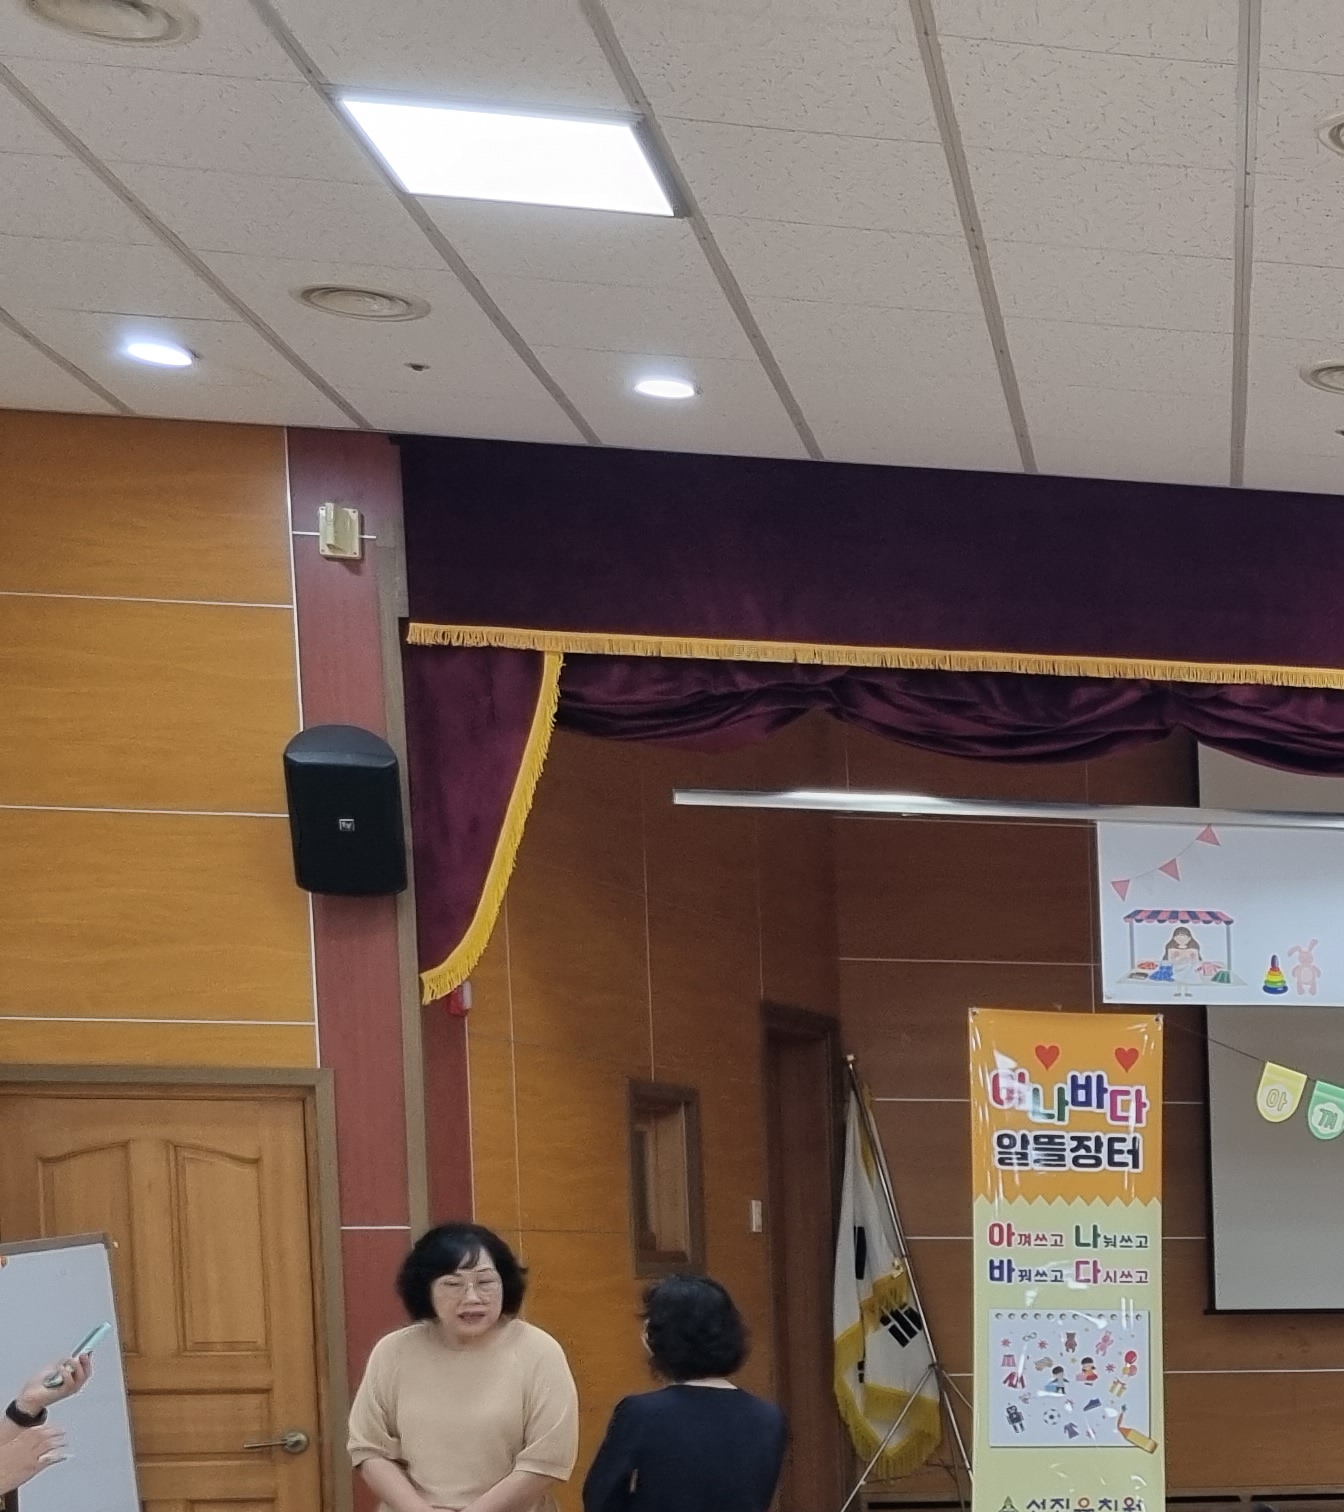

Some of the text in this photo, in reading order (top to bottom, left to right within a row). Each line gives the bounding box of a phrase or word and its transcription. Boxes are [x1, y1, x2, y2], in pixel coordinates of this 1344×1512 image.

[996, 1132, 1140, 1169] 알뜰장터
[988, 1223, 1148, 1249] 아껴쓰고 나눠쓰고
[988, 1258, 1148, 1284] 바꿔쓰고 다시쓰고
